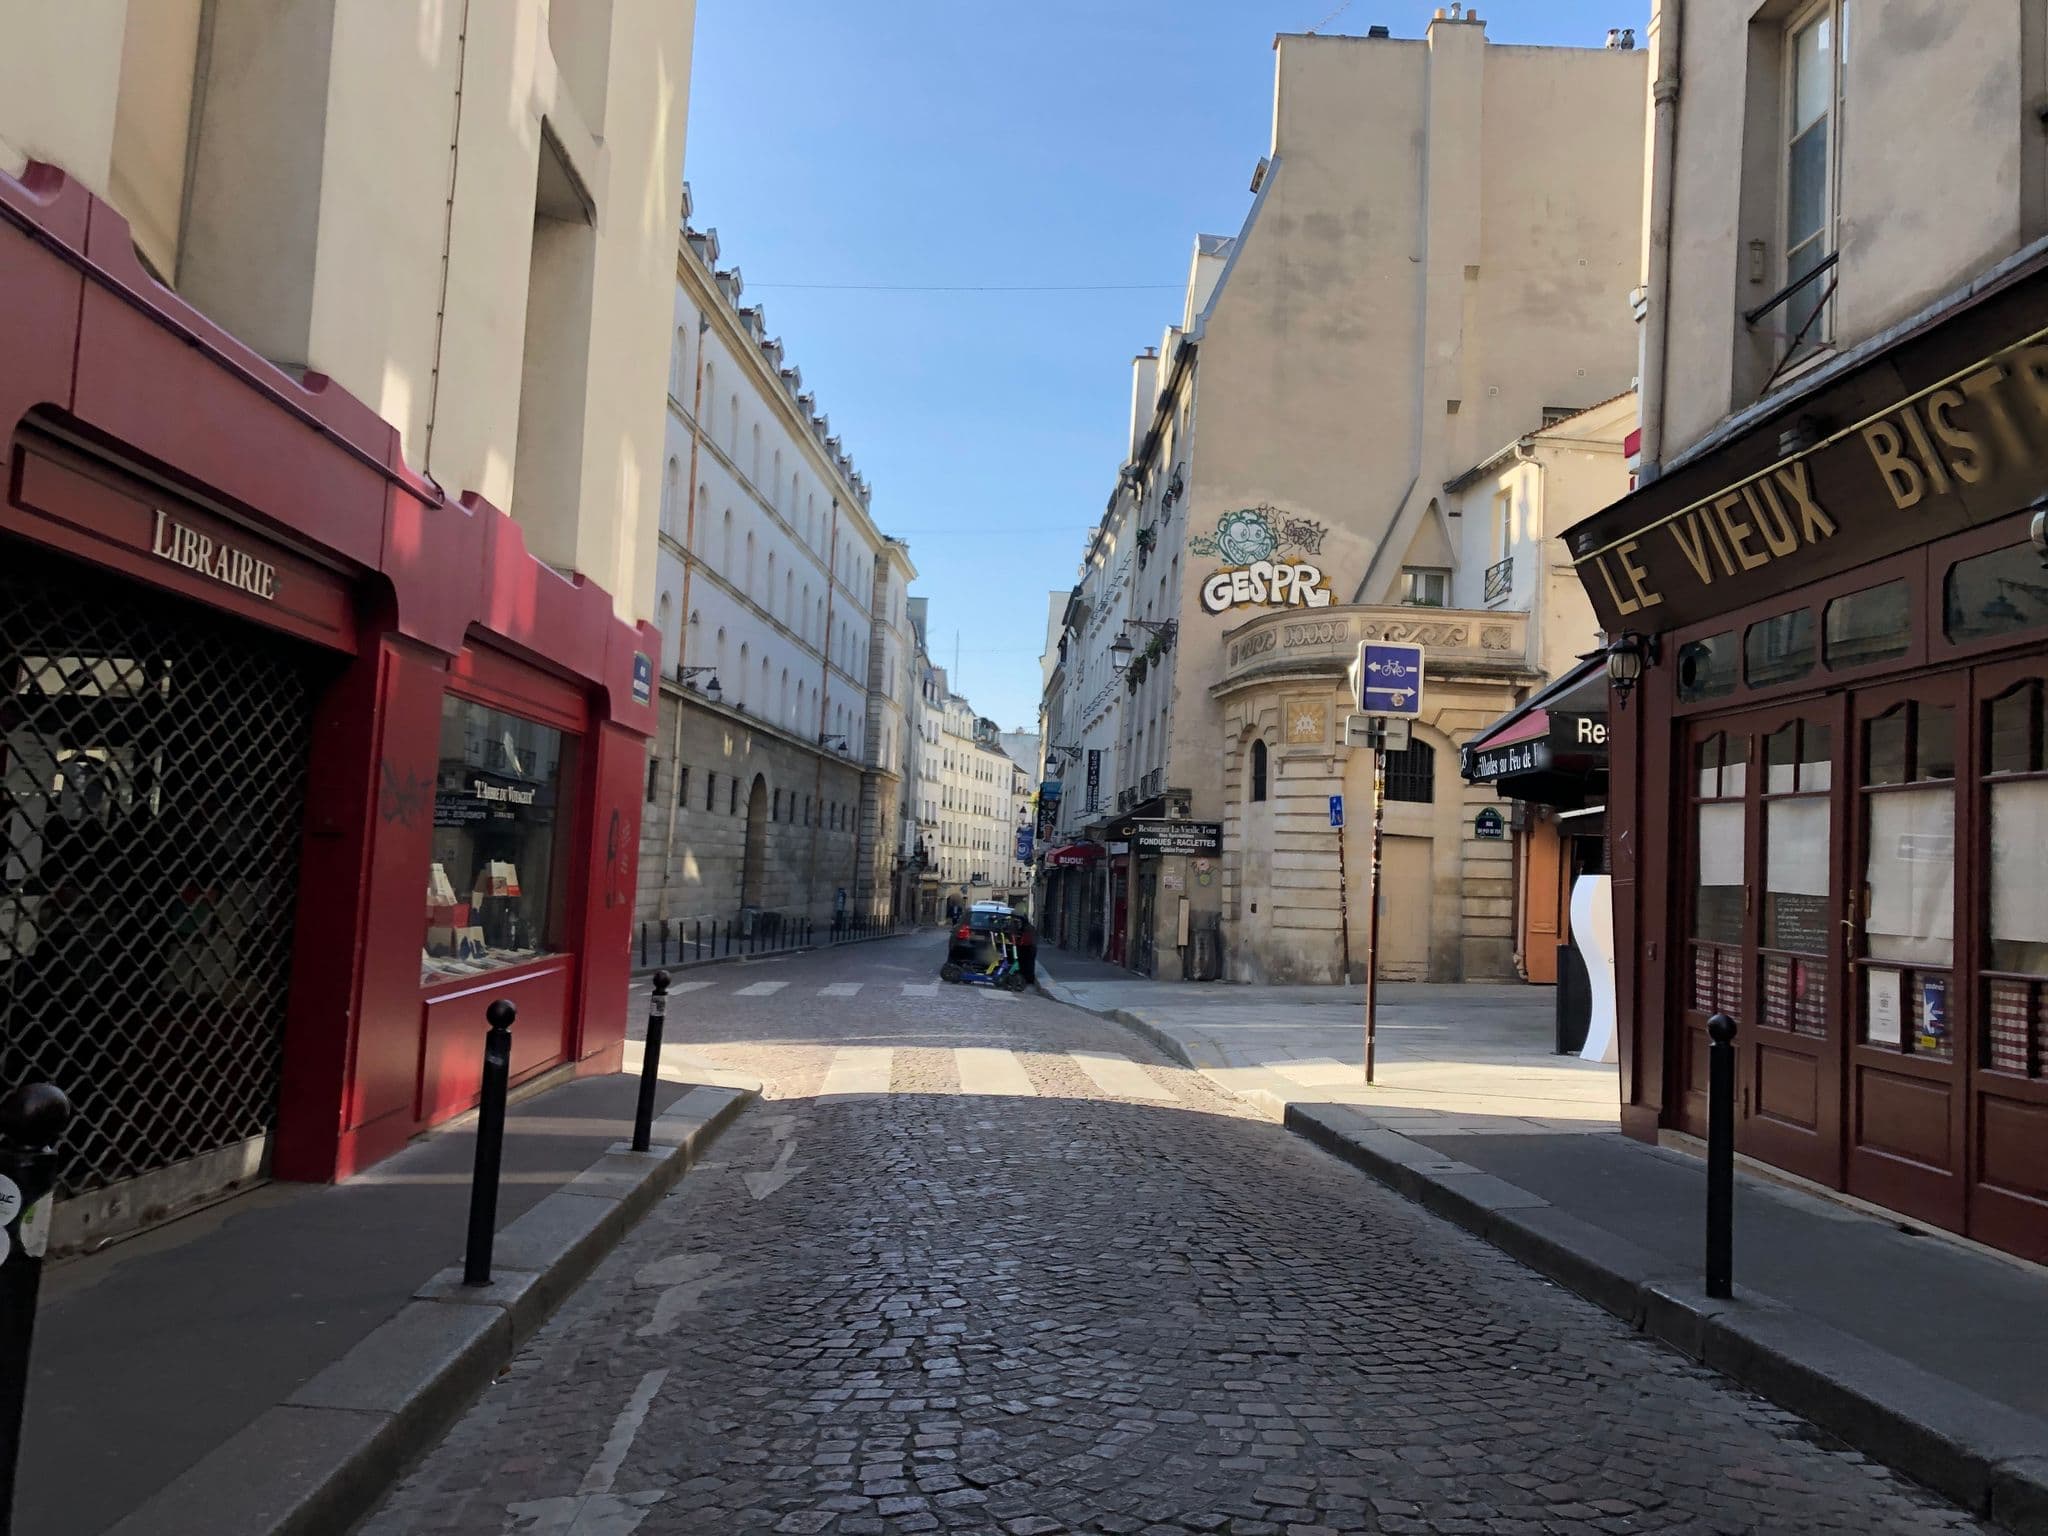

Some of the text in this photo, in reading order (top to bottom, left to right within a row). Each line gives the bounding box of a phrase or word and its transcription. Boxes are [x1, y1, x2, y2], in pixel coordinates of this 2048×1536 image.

[1597, 541, 1663, 616] LE
[1667, 461, 1837, 585] VIEUX
[152, 509, 276, 600] LIBRAIRIE
[1202, 560, 1332, 613] GESPR
[1578, 717, 1610, 744] Re
[1523, 745, 1531, 768] de
[1139, 837, 1172, 846] FONDUES
[1176, 838, 1217, 847] RACLETTES
[1202, 825, 1217, 834] Tour
